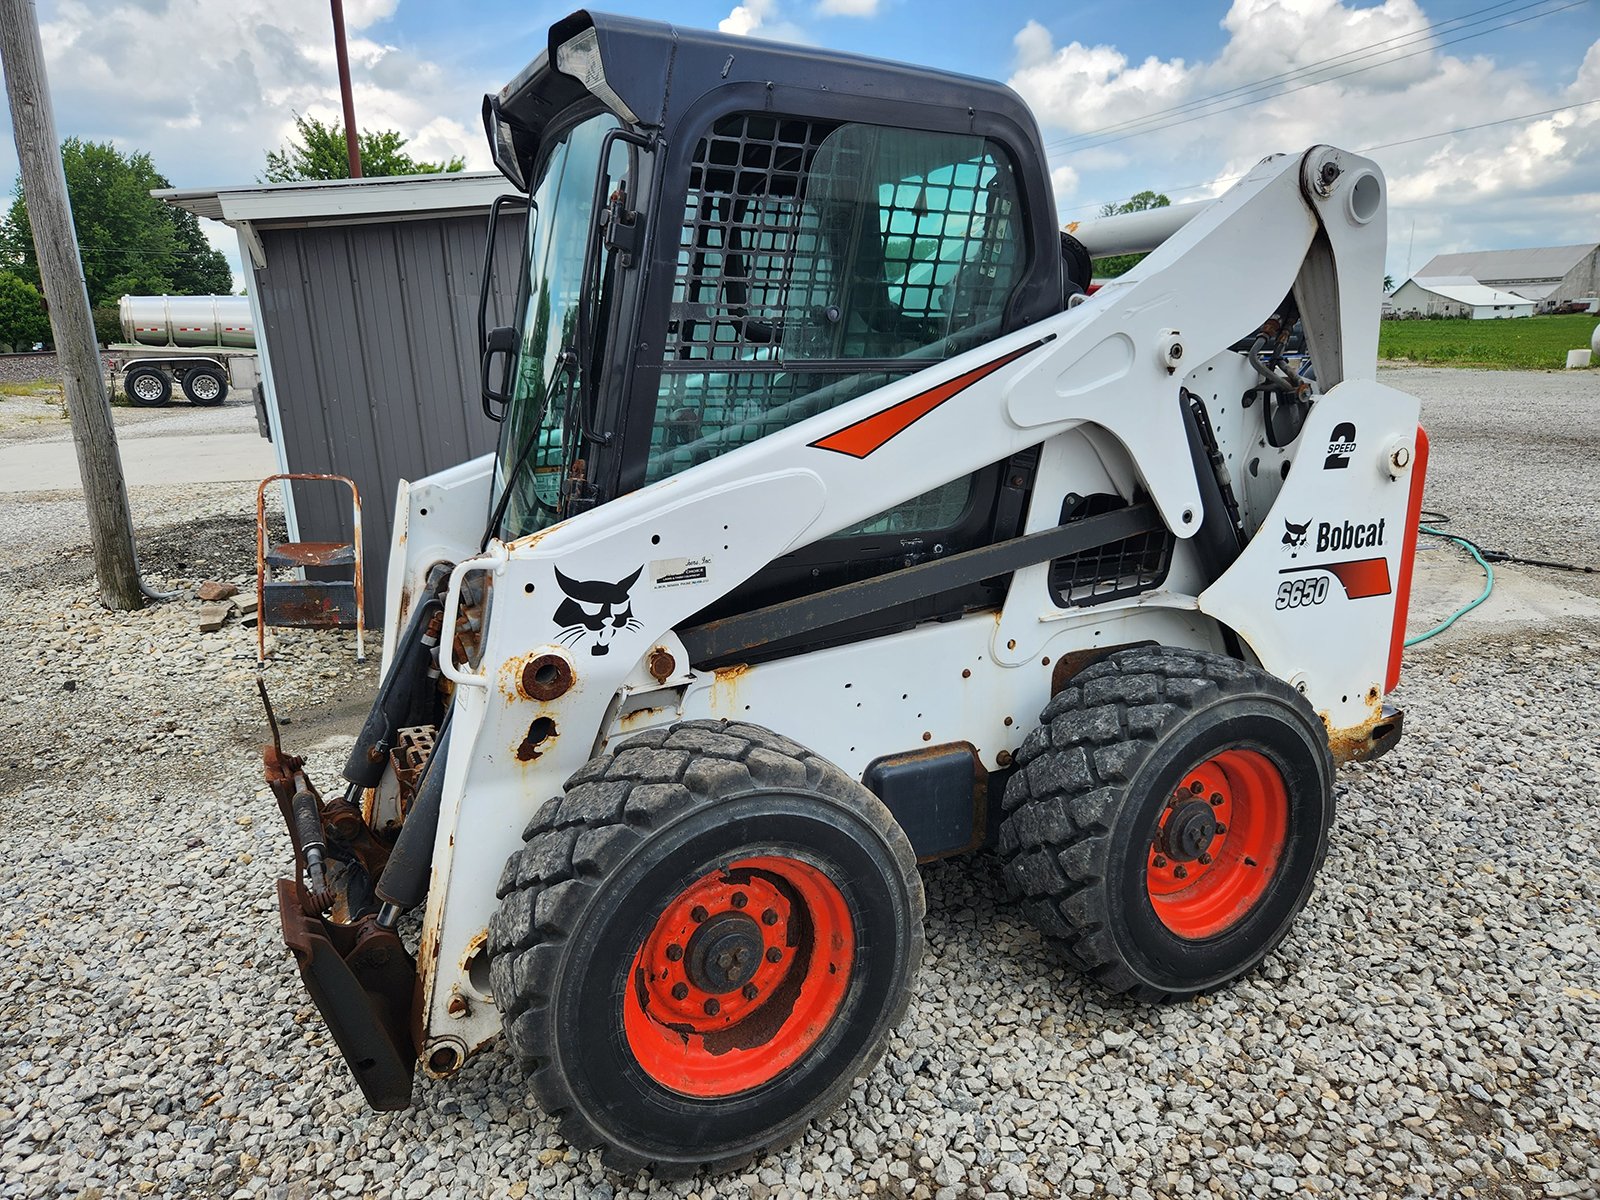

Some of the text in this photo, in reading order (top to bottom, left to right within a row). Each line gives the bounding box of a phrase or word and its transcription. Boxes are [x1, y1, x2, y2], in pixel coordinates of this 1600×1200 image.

[1323, 422, 1356, 470] 2
[1327, 443, 1356, 454] SPEED
[1316, 518, 1385, 552] Bobcat
[1275, 576, 1331, 610] S650
